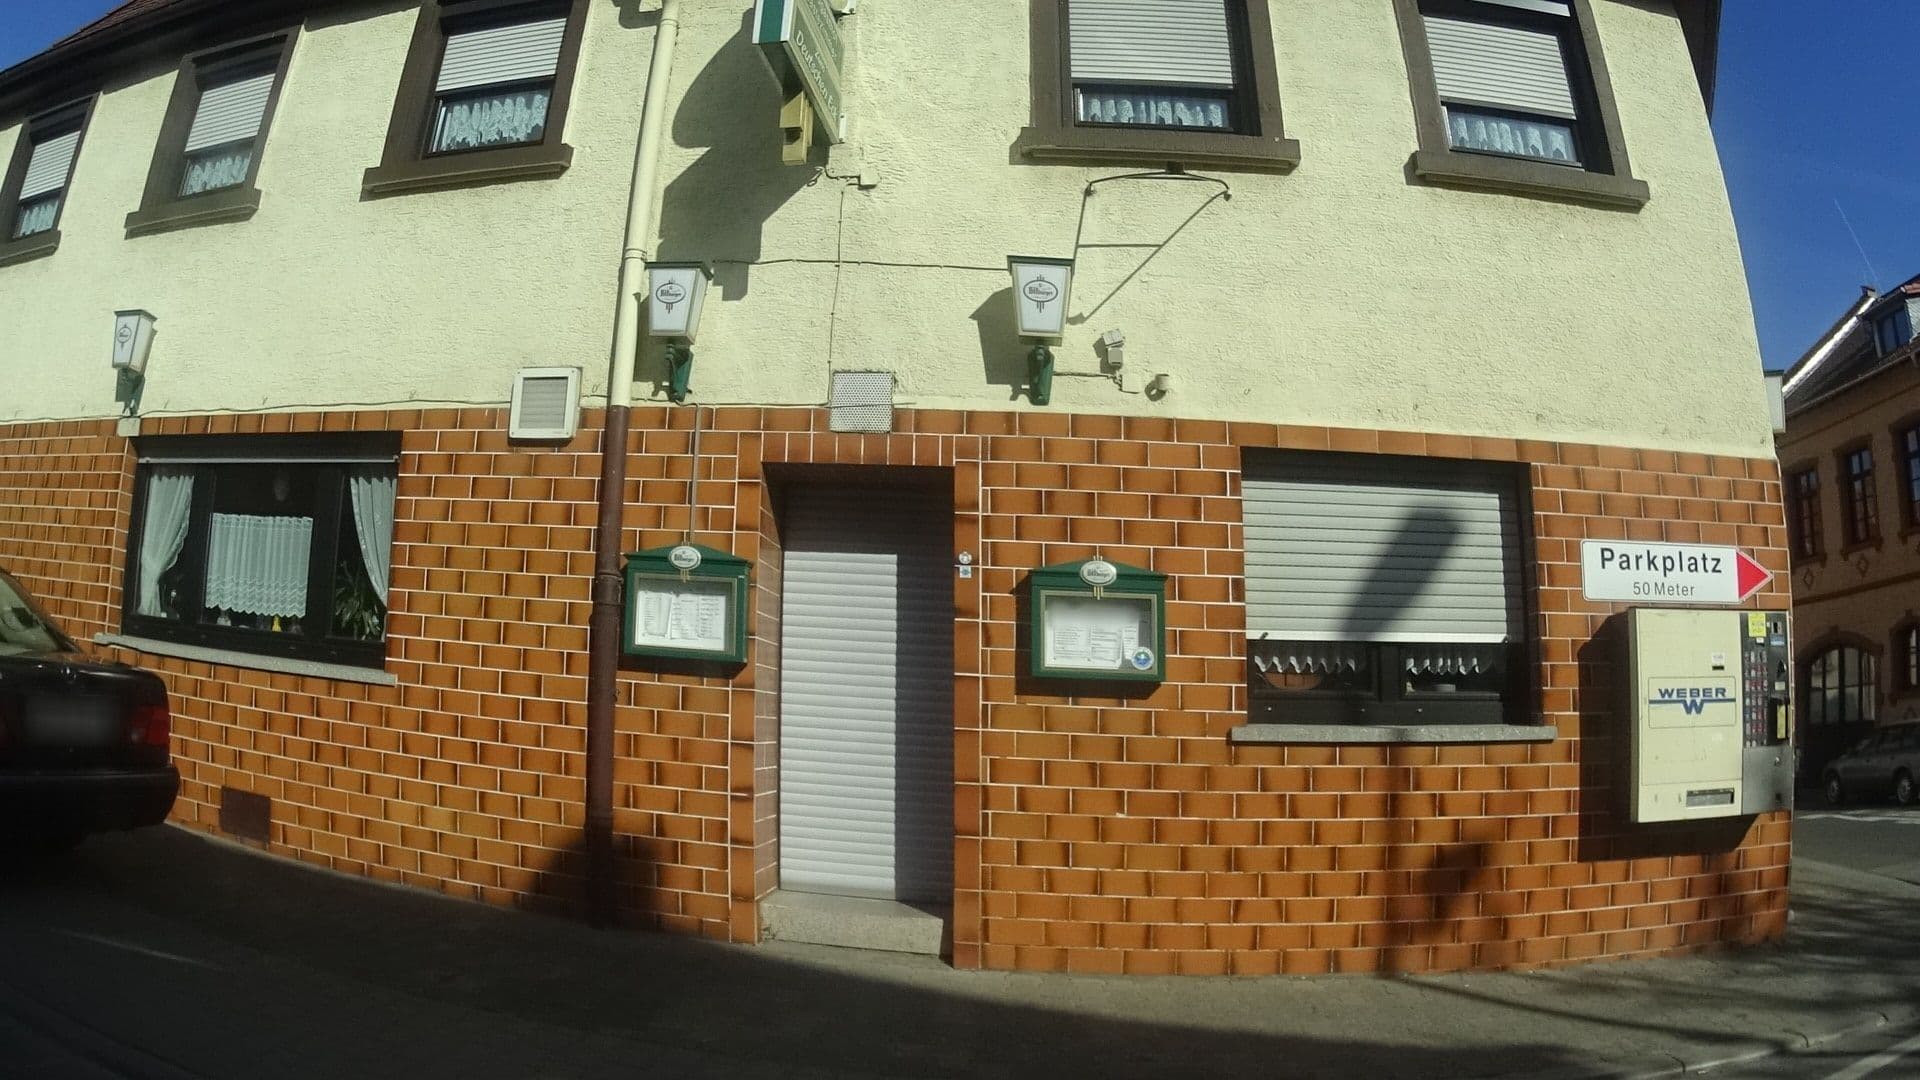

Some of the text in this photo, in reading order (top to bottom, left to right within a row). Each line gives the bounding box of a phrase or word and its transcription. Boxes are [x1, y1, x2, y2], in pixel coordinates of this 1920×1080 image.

[1600, 547, 1722, 577] Parkplatz
[1633, 582, 1695, 597] 50 Meter
[1658, 687, 1727, 699] WEBER
